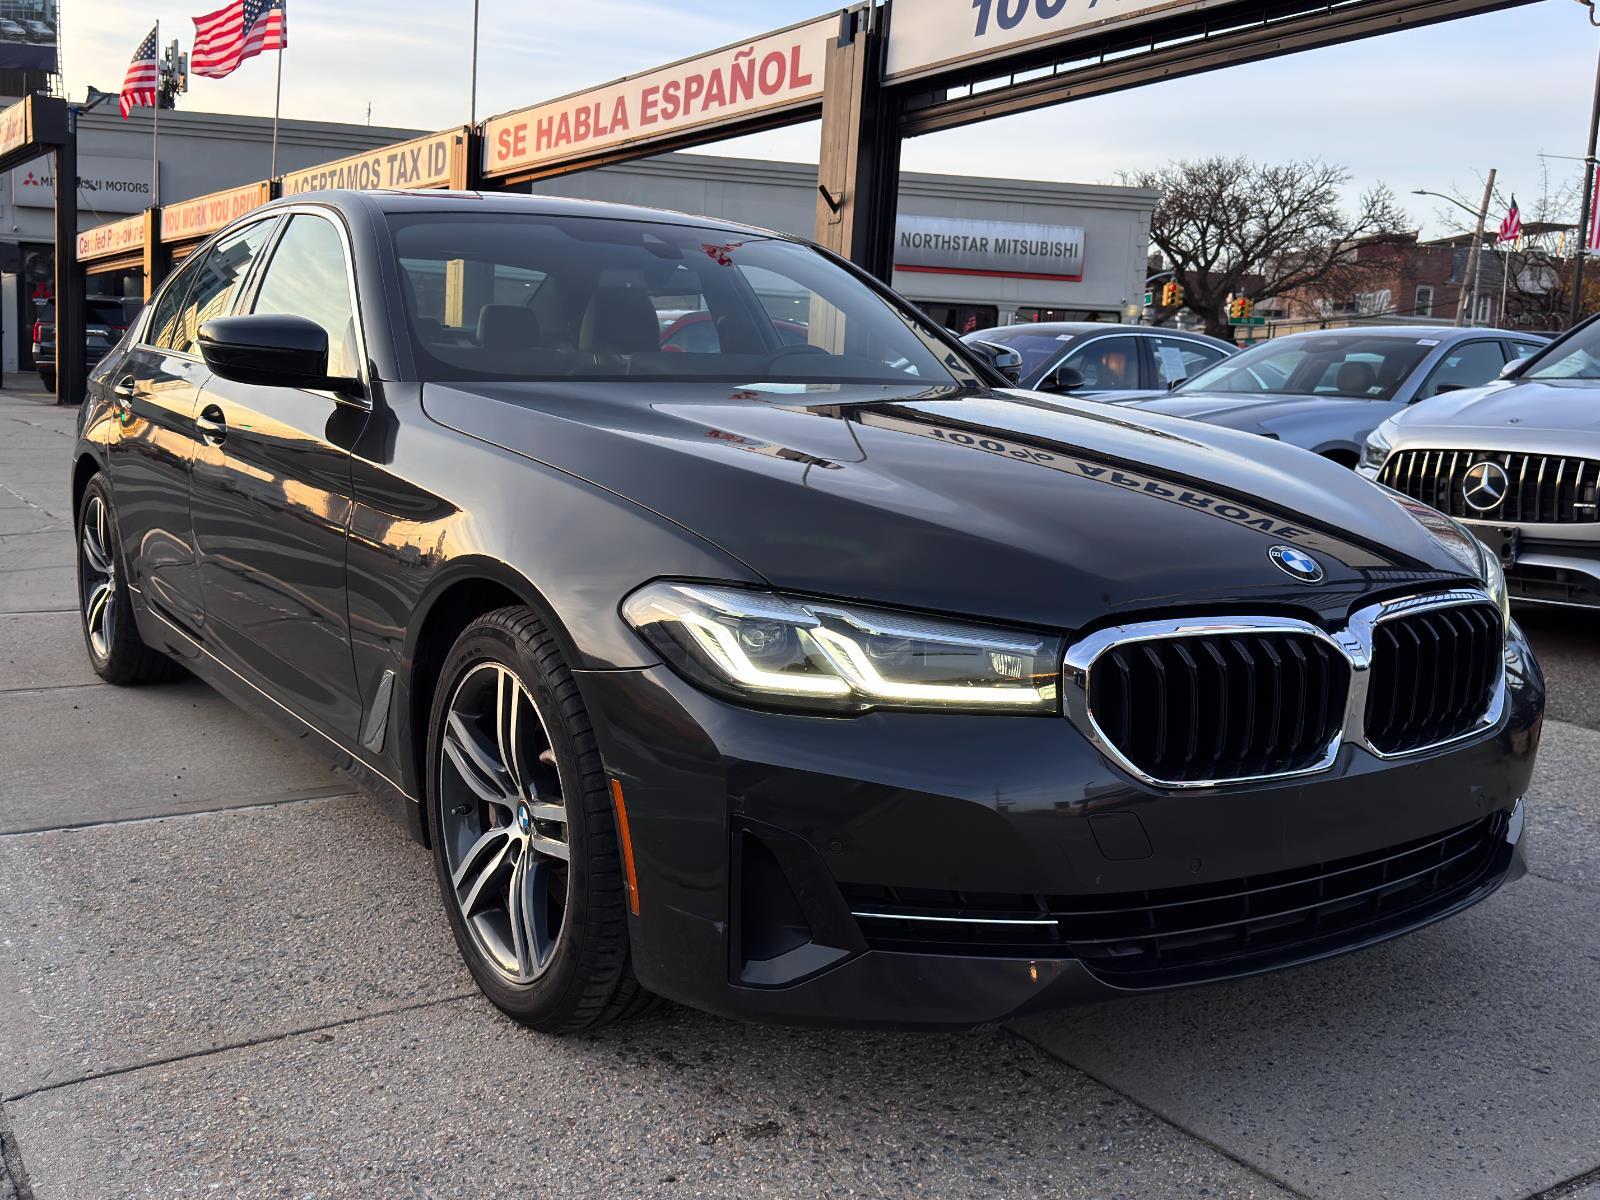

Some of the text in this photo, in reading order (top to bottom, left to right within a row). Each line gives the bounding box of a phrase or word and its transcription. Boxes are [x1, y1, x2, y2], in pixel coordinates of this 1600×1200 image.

[497, 45, 812, 160] SE HABLA ESPAÑOL
[387, 146, 422, 186] TAX
[427, 141, 447, 178] ID
[106, 180, 149, 194] MOTORS
[164, 190, 261, 232] YOU WORK YOU DRIV
[901, 232, 1078, 259] NORTHSTAR MITSUBISHI
